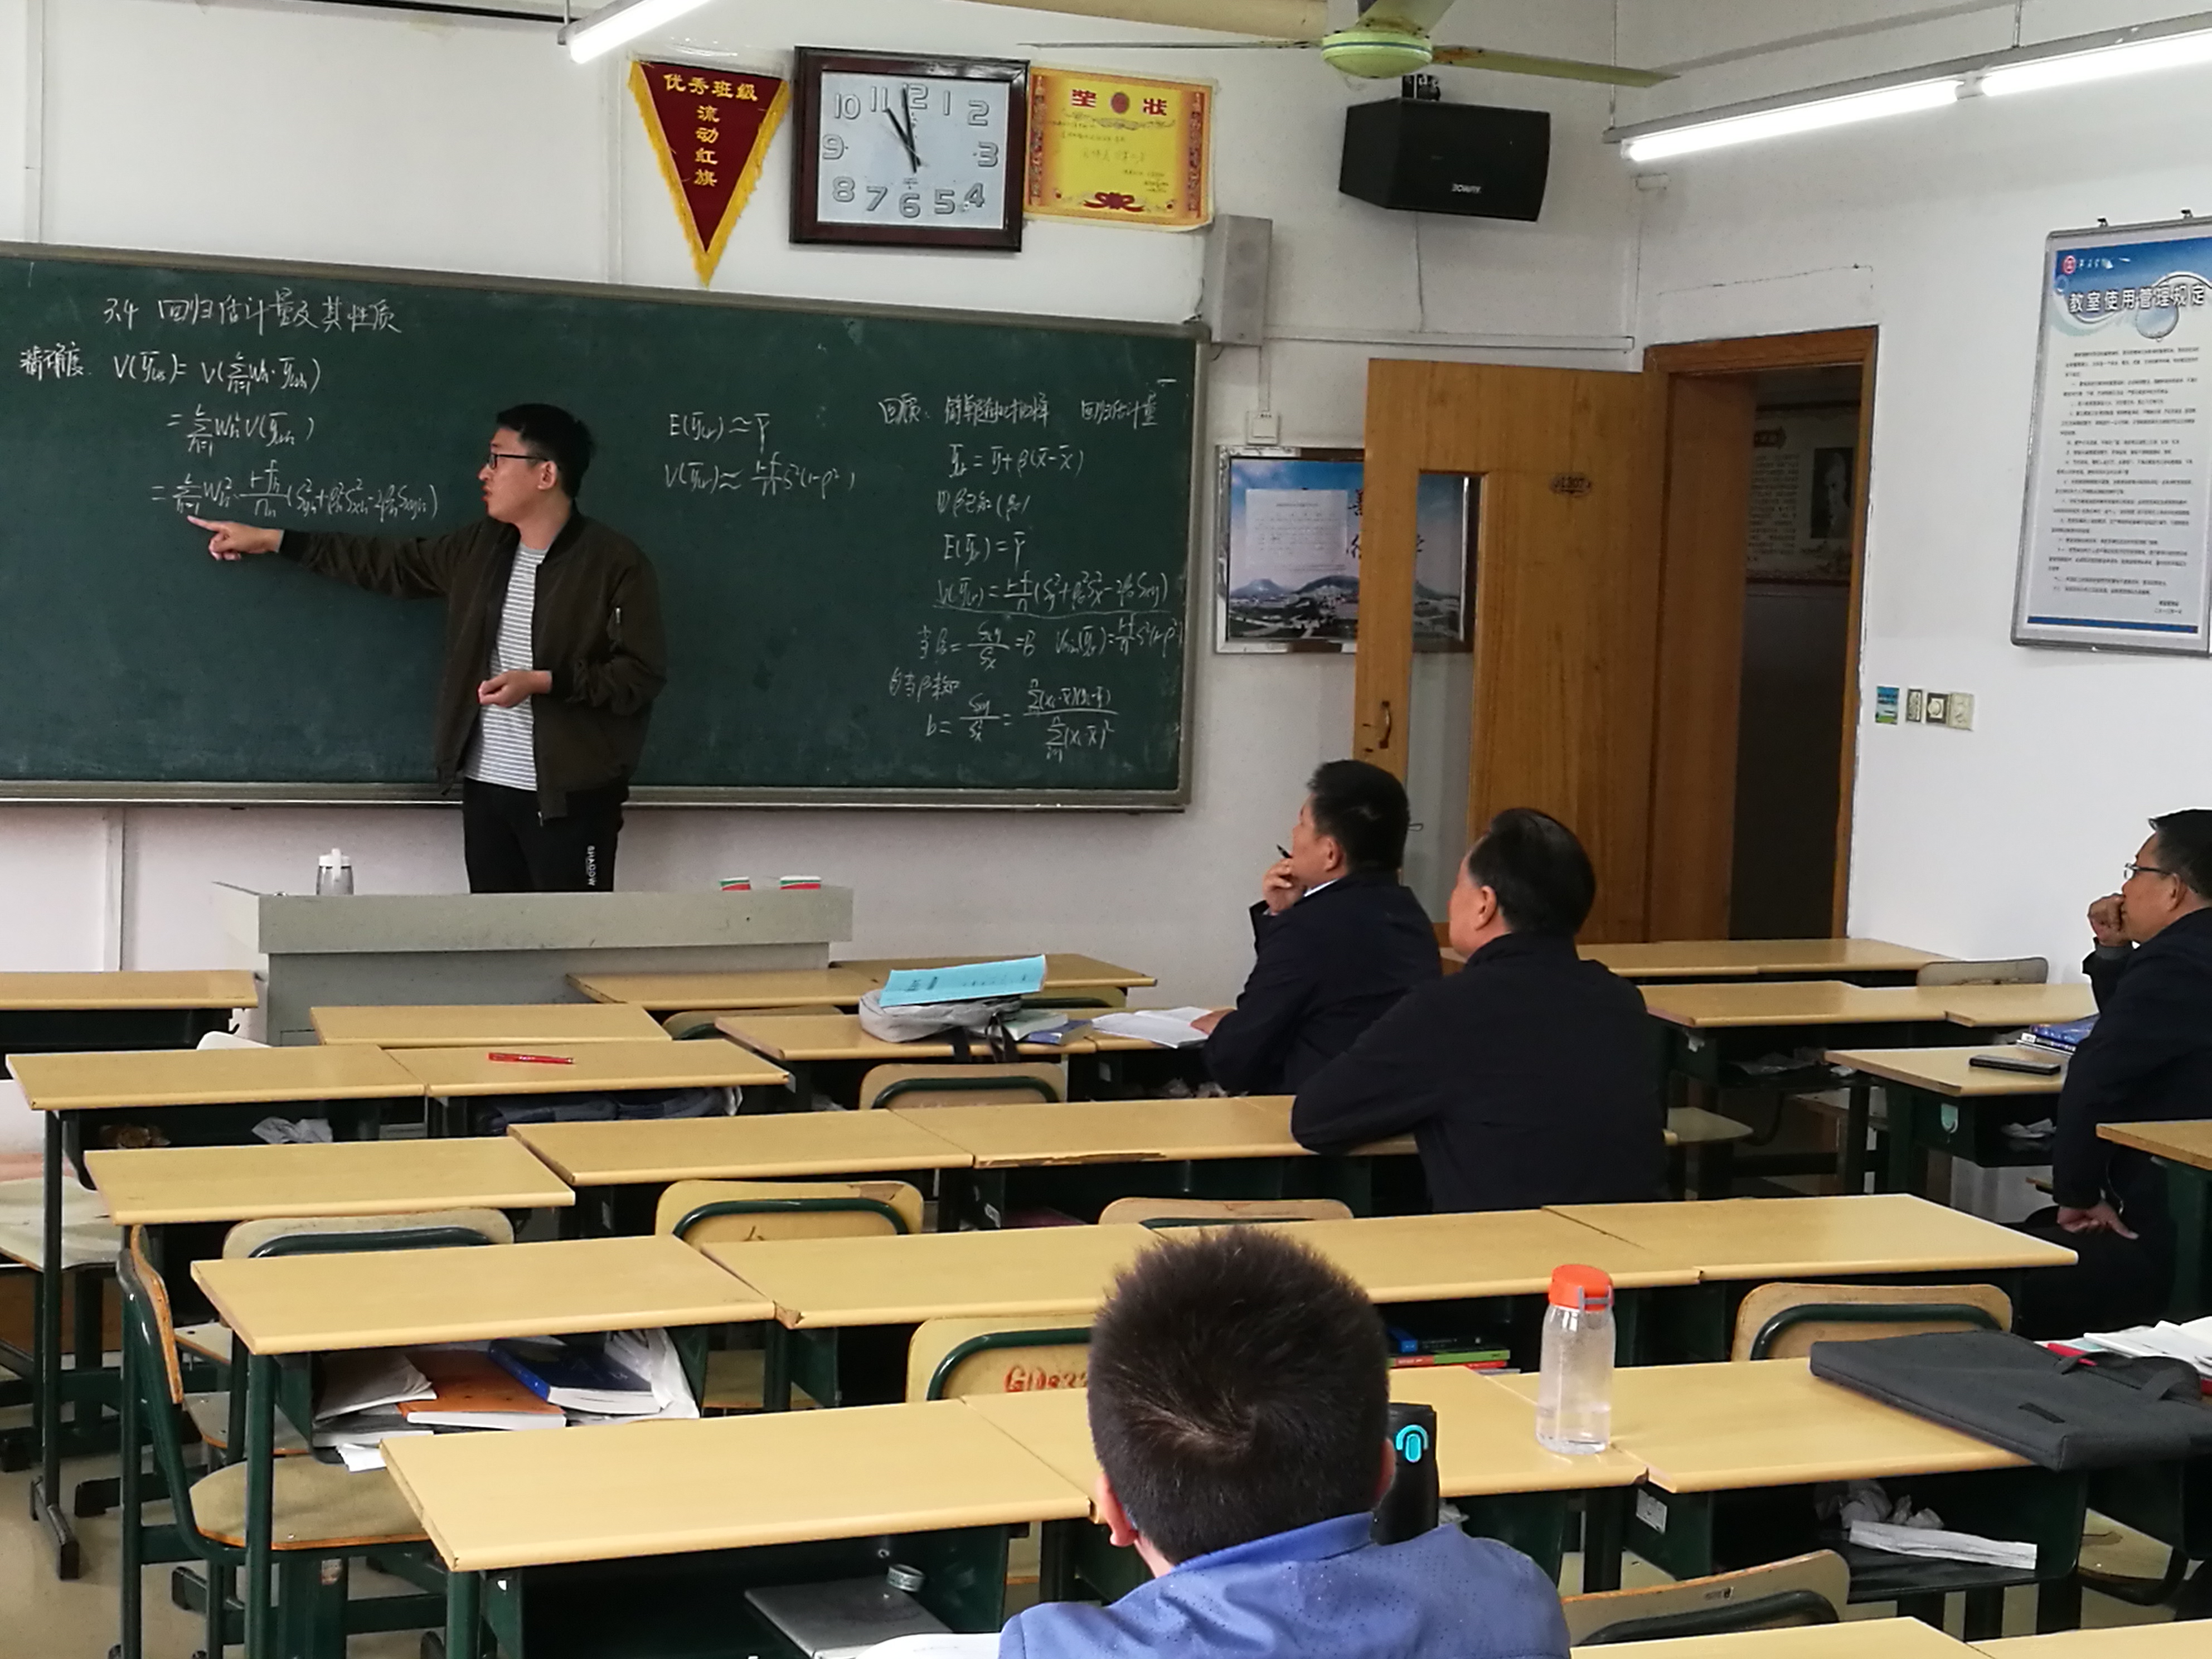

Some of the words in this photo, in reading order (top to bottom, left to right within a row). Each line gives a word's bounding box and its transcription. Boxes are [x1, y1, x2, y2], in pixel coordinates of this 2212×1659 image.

[663, 74, 758, 101] 优秀班级
[870, 86, 889, 113] 11
[835, 93, 861, 119] 10
[943, 90, 951, 116] 1
[967, 99, 989, 127] 2
[694, 105, 720, 187] 流动红旗
[822, 134, 845, 160] 9
[977, 141, 999, 168] 3
[832, 176, 856, 203] 8
[866, 186, 889, 212] 7
[934, 188, 955, 215] 5
[964, 182, 985, 208] 4
[899, 192, 921, 219] 6
[158, 287, 402, 336] 回归估计量及其性质
[2069, 284, 2205, 314] 教室使用管理规定
[1081, 390, 1158, 429] 回归估计量
